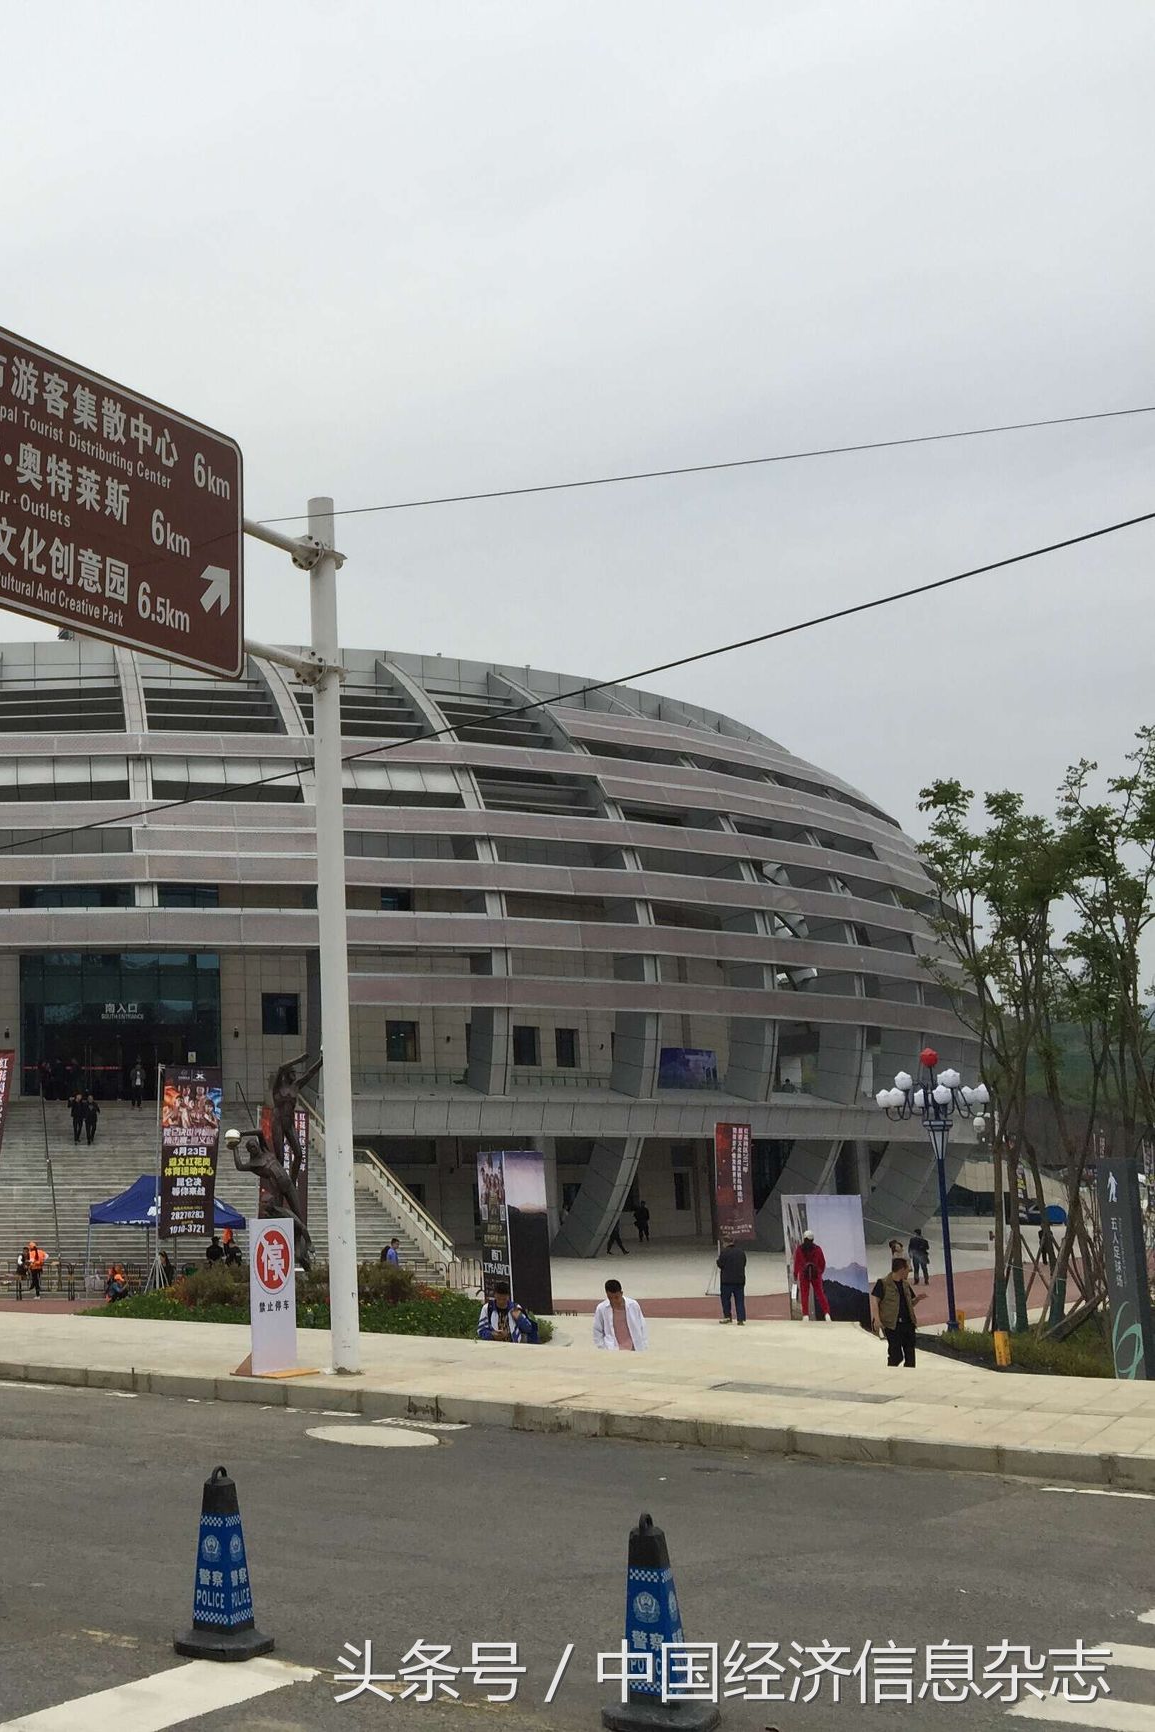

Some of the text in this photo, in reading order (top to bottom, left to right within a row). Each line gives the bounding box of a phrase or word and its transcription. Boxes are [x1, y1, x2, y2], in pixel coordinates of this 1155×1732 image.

[21, 410, 64, 445] Tourist
[69, 429, 133, 477] Distributing
[136, 459, 172, 490] Center
[193, 452, 231, 500] 6km
[20, 496, 72, 529] Outlets
[150, 508, 191, 558] 6km
[36, 581, 57, 606] And
[58, 588, 100, 620] Creative
[102, 603, 124, 628] Park
[137, 581, 190, 633] 6.5km
[173, 1147, 207, 1156] 4月23日
[169, 1223, 205, 1234] 1010-3721
[261, 1238, 285, 1282] 停
[259, 1300, 290, 1313] 禁止停车
[199, 1568, 223, 1587] 警察
[196, 1589, 225, 1609] POLICE
[231, 1587, 251, 1609] POLICE
[631, 1630, 665, 1651] 警察
